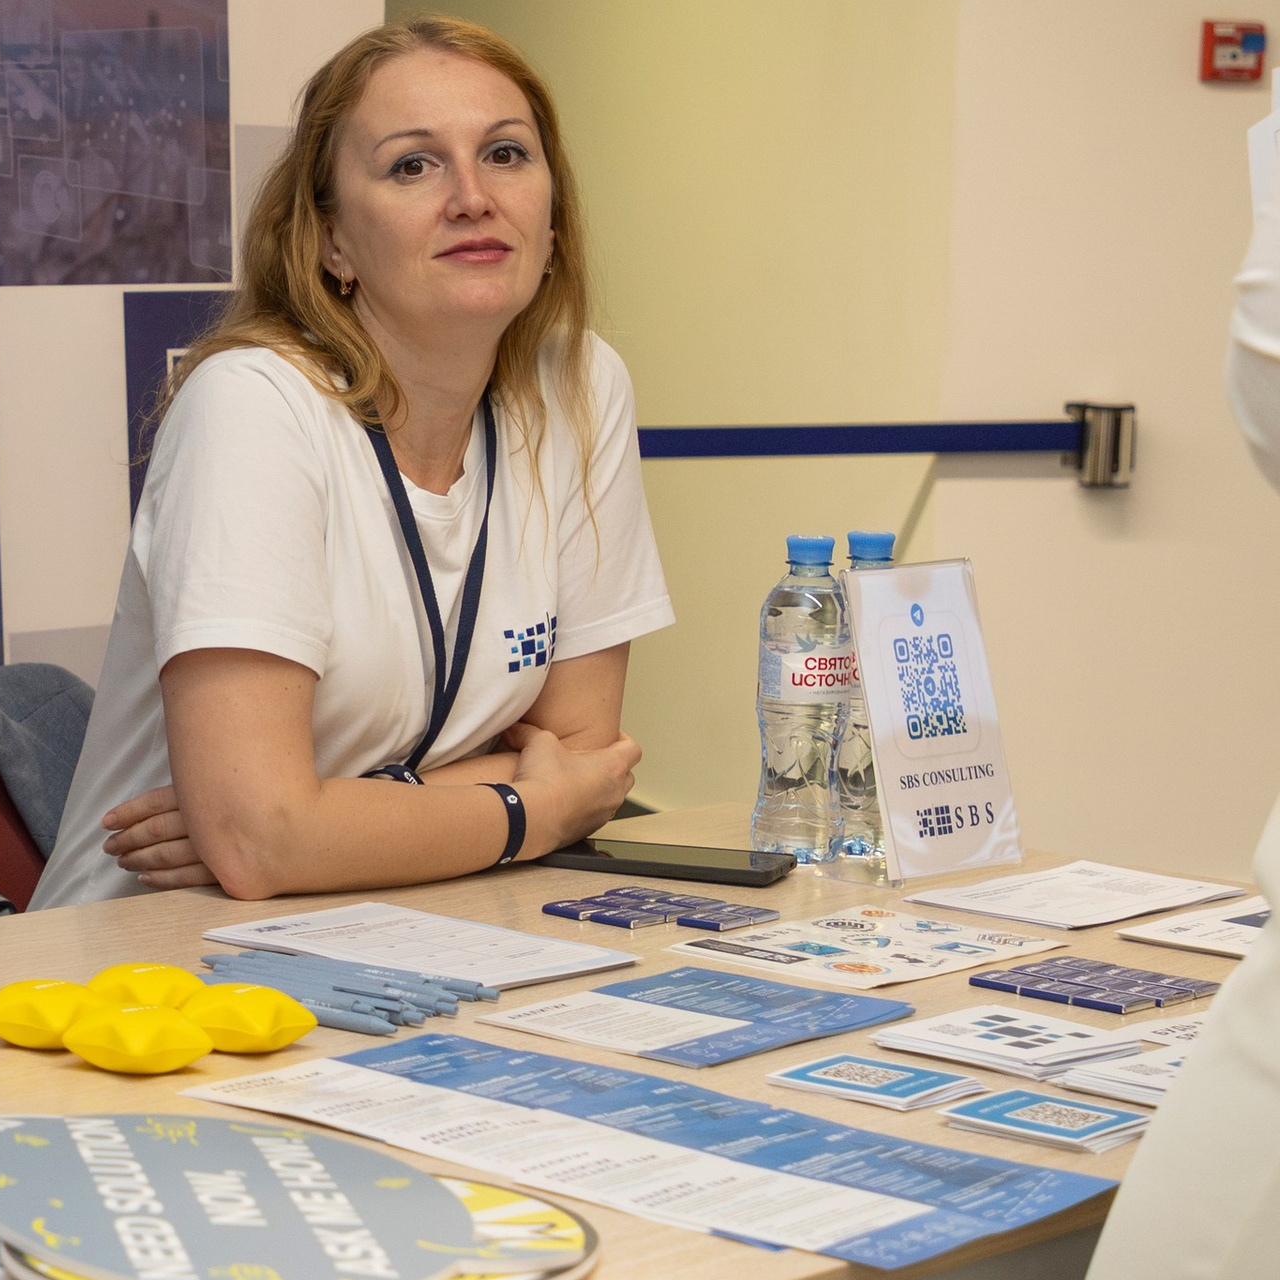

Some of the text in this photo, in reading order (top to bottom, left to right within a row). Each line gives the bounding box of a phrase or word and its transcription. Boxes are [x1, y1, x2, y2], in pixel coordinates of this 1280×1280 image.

[899, 763, 995, 791] SBS CONSULTING
[954, 801, 995, 830] SBS
[62, 1117, 165, 1214] SOLUTION
[183, 1169, 269, 1227] NOW,
[288, 1189, 365, 1226] ME
[311, 1226, 402, 1280] ASK
